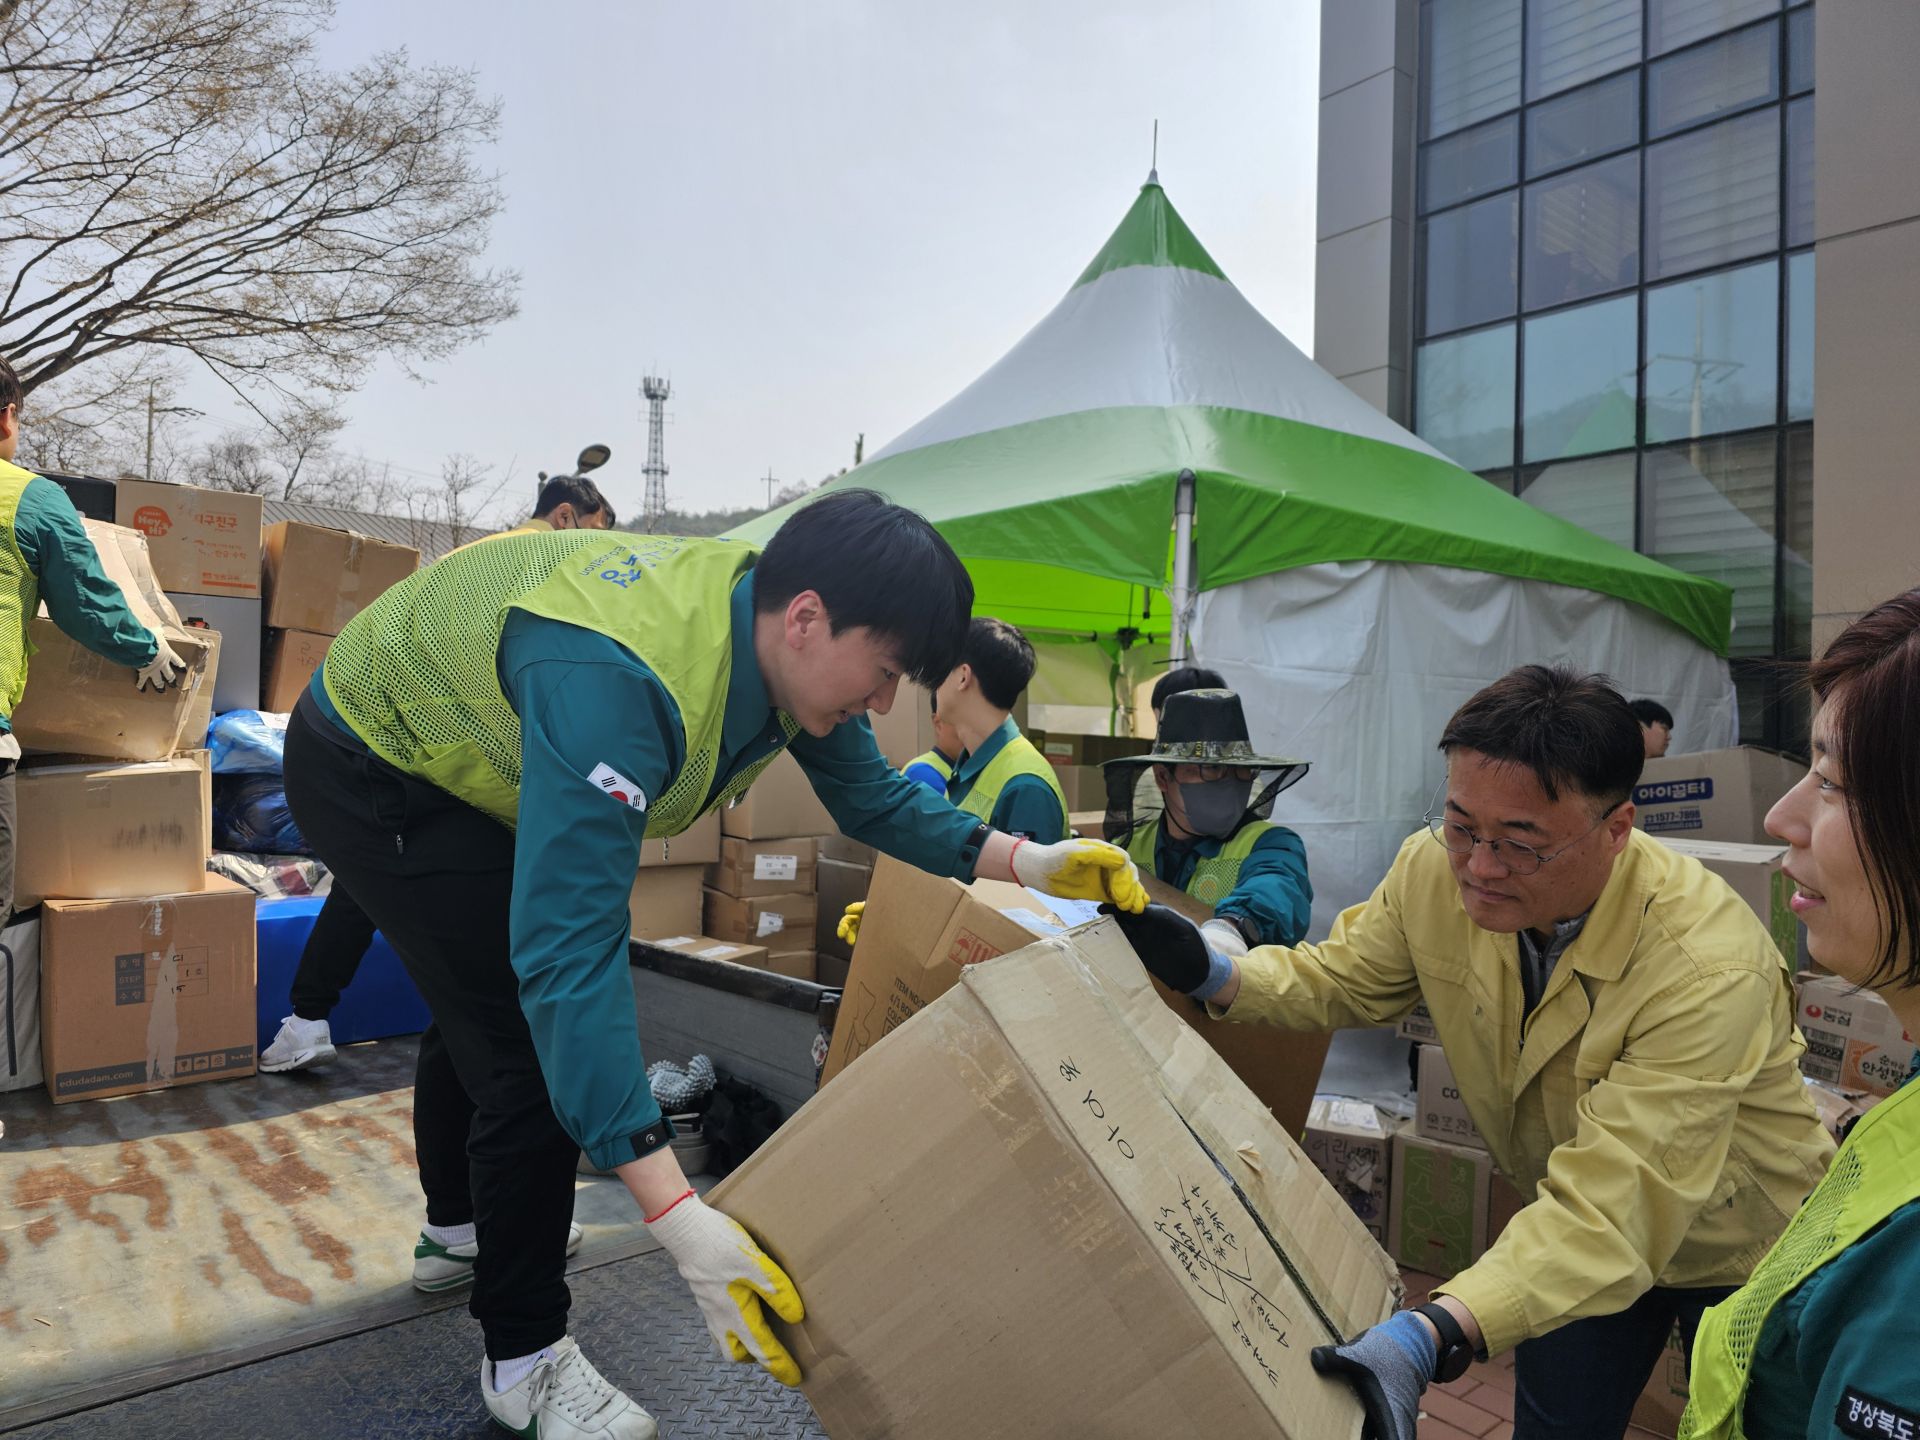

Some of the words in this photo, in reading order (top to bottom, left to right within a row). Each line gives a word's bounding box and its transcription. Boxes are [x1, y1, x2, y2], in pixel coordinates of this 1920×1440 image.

[59, 1070, 134, 1089] edudadam.com
[1862, 1061, 1905, 1084] 안성탕
[1848, 1396, 1914, 1440] 경상북도
